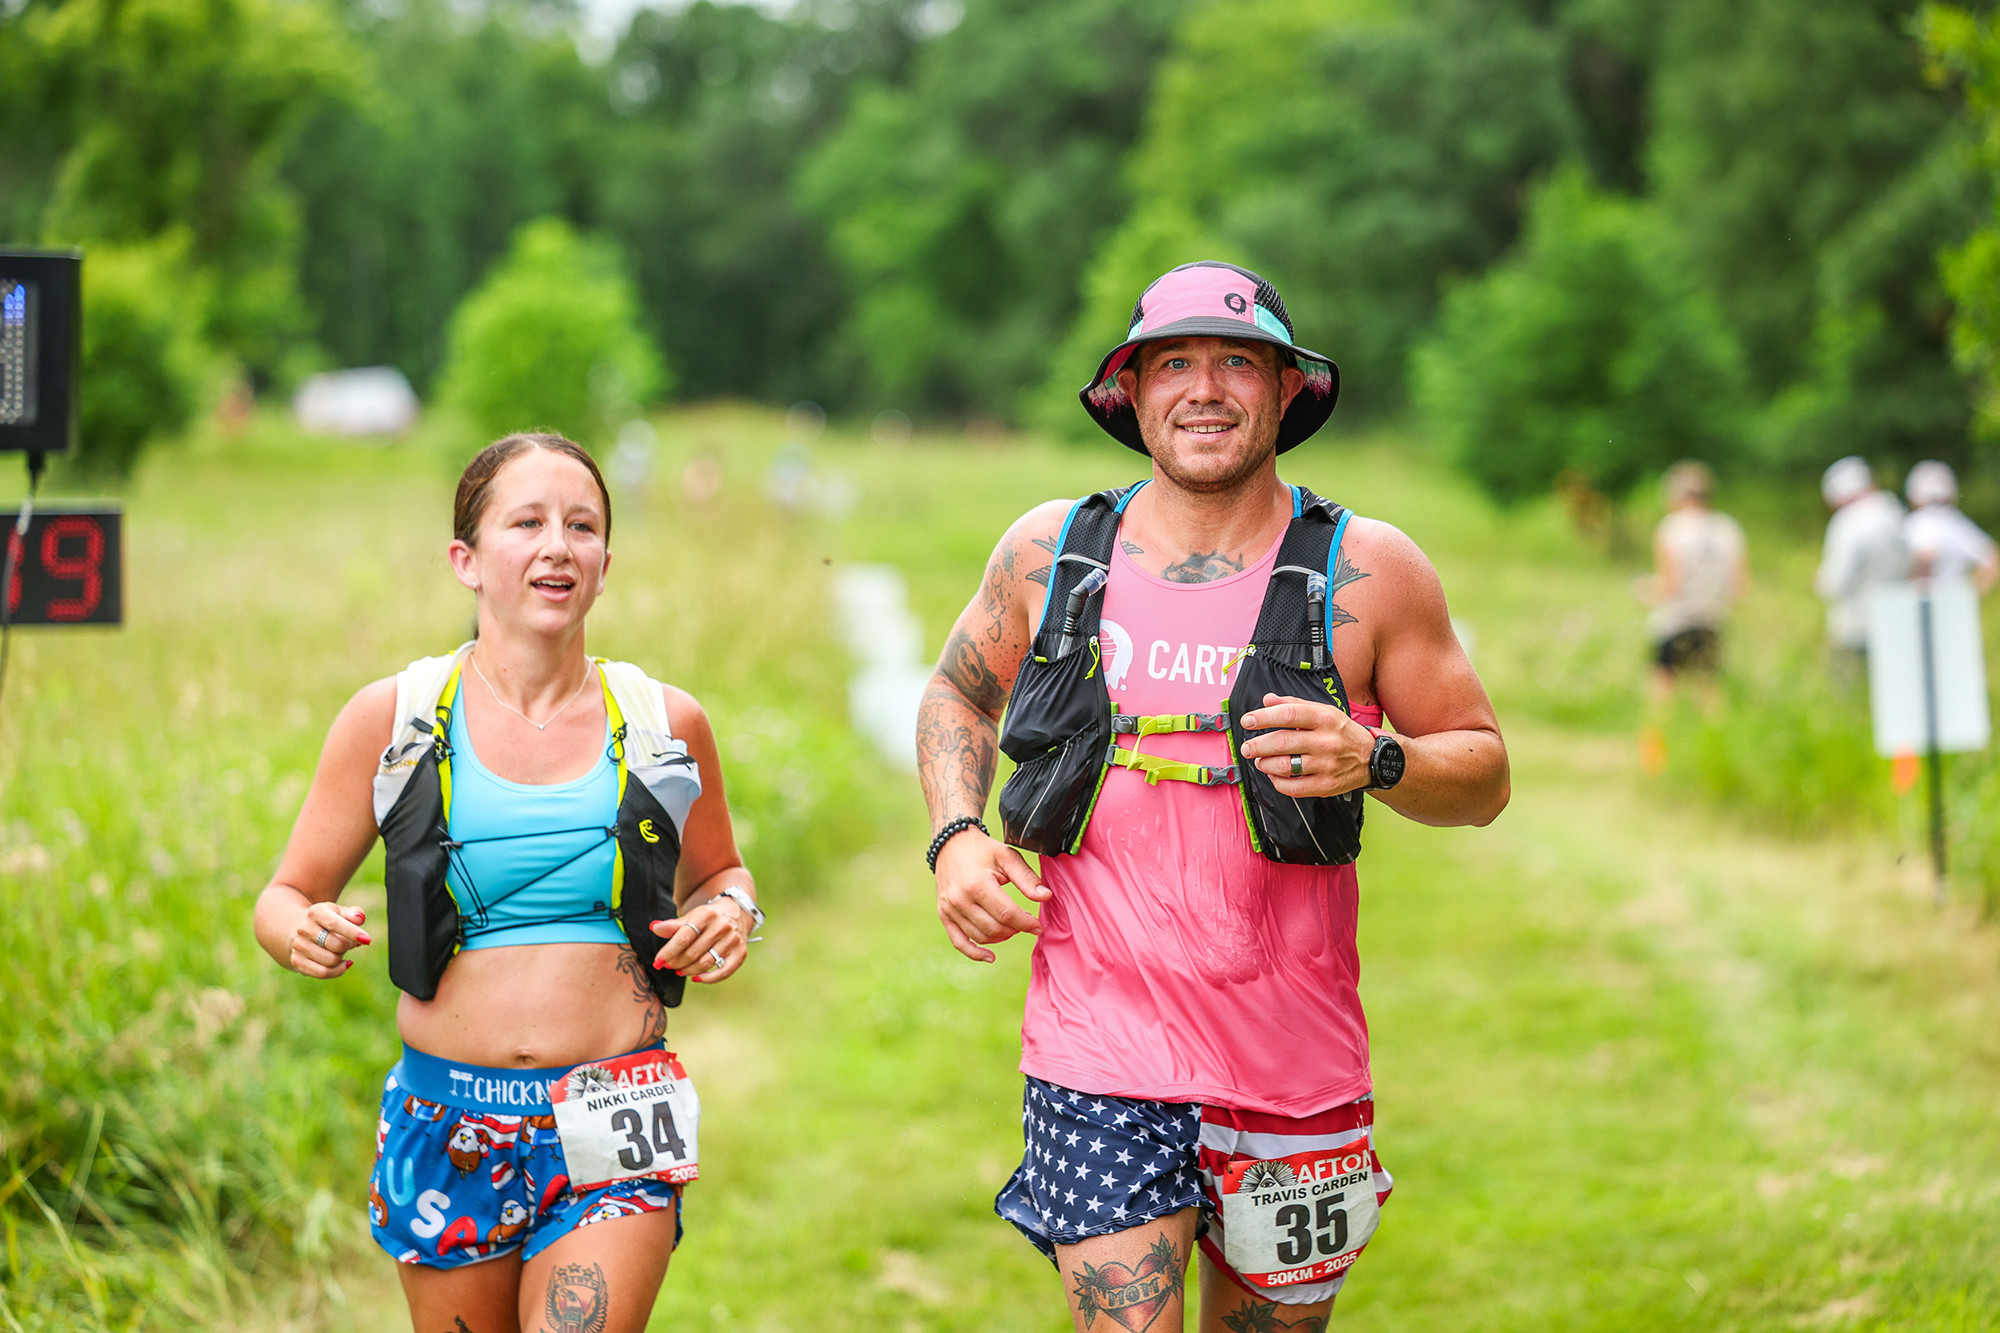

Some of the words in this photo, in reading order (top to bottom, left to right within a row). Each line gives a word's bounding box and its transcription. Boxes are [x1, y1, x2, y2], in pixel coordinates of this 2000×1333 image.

[587, 1093, 627, 1112] NIKKI
[611, 1101, 687, 1170] 34
[1251, 1187, 1307, 1207] TRAVIS
[1311, 1171, 1368, 1196] CARDEN
[1275, 1192, 1348, 1265] 35
[1267, 1267, 1313, 1286] 50KM
[1324, 1252, 1357, 1274] 2025
[1108, 1277, 1160, 1307] MOM
